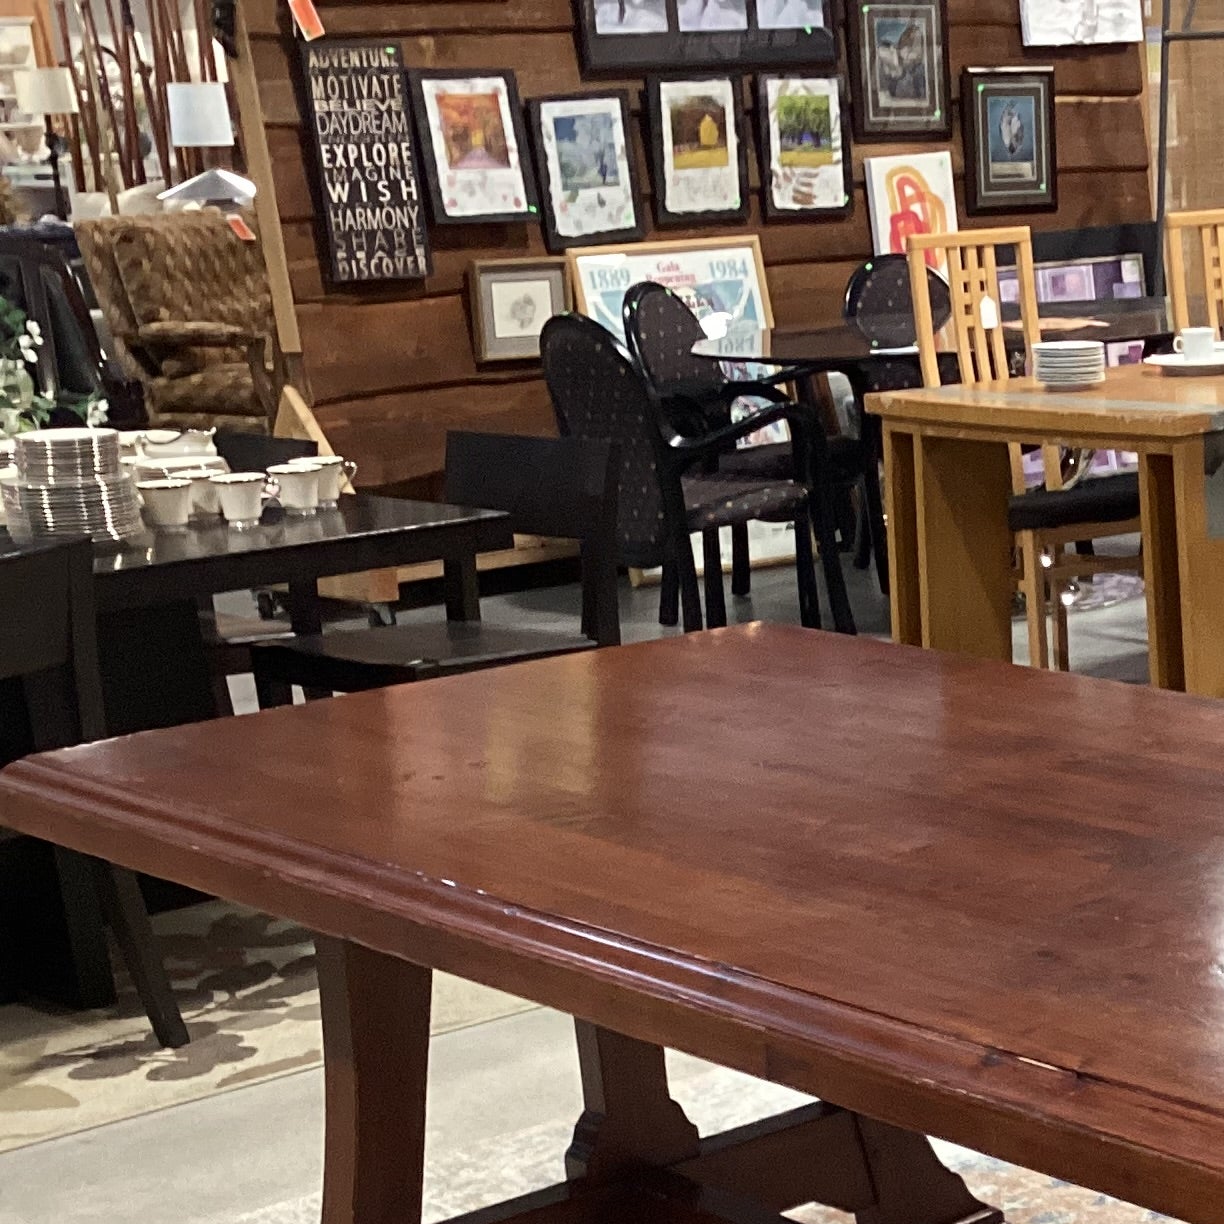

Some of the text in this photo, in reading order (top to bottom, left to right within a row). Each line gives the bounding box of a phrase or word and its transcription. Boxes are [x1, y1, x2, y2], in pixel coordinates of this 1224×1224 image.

[309, 47, 399, 68] ADVENTURE
[311, 74, 401, 100] MOTIVATE
[314, 98, 403, 112] BELIEVE
[316, 110, 408, 135] DAYDREAM
[321, 142, 411, 169] EXPLORE
[324, 165, 414, 184] IMAGINE
[327, 179, 418, 203] WISH
[330, 206, 419, 232] HARMONY
[333, 228, 424, 253] SHARE
[337, 254, 428, 280] DISCOVER
[709, 257, 750, 279] 1984
[589, 268, 631, 291] 1889
